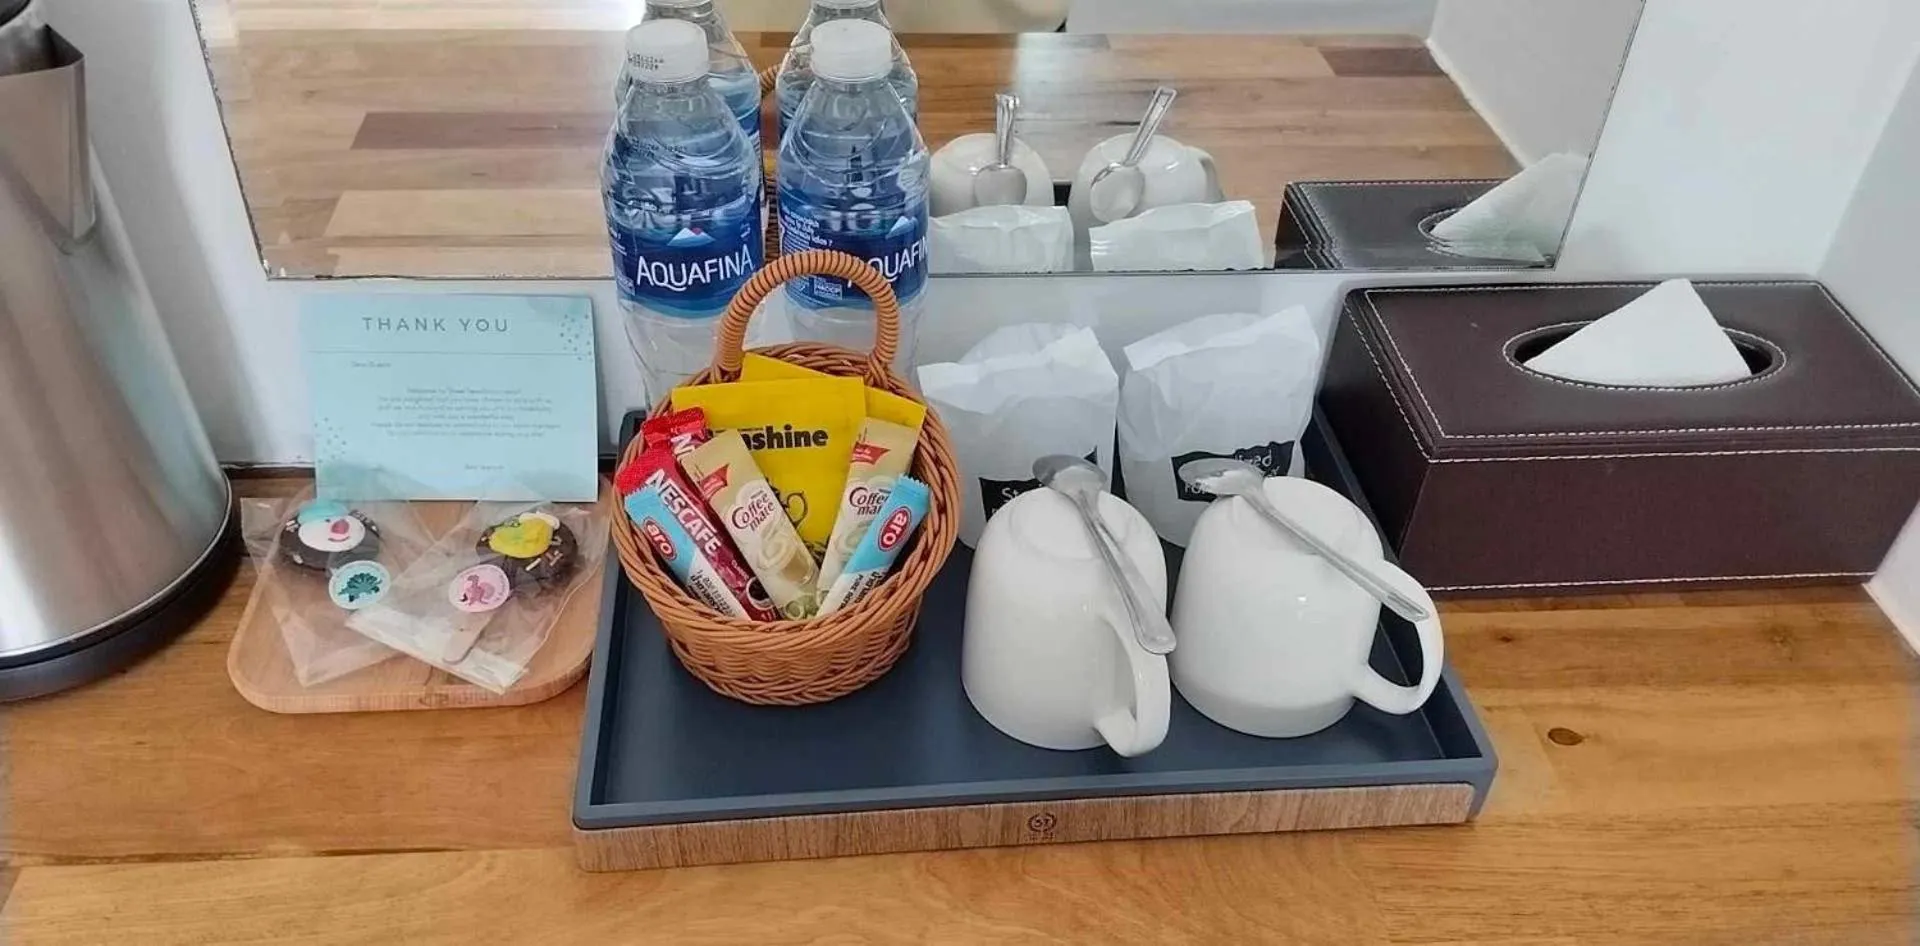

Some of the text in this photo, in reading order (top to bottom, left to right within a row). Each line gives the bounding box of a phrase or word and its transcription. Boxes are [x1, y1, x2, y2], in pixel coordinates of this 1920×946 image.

[637, 244, 754, 291] AQUAFINA
[848, 236, 928, 288] QUAFIN
[362, 317, 508, 333] THANK YOU
[732, 493, 769, 529] Coffee
[750, 502, 775, 531] mate
[647, 524, 673, 555] aro
[882, 512, 907, 545] aro
